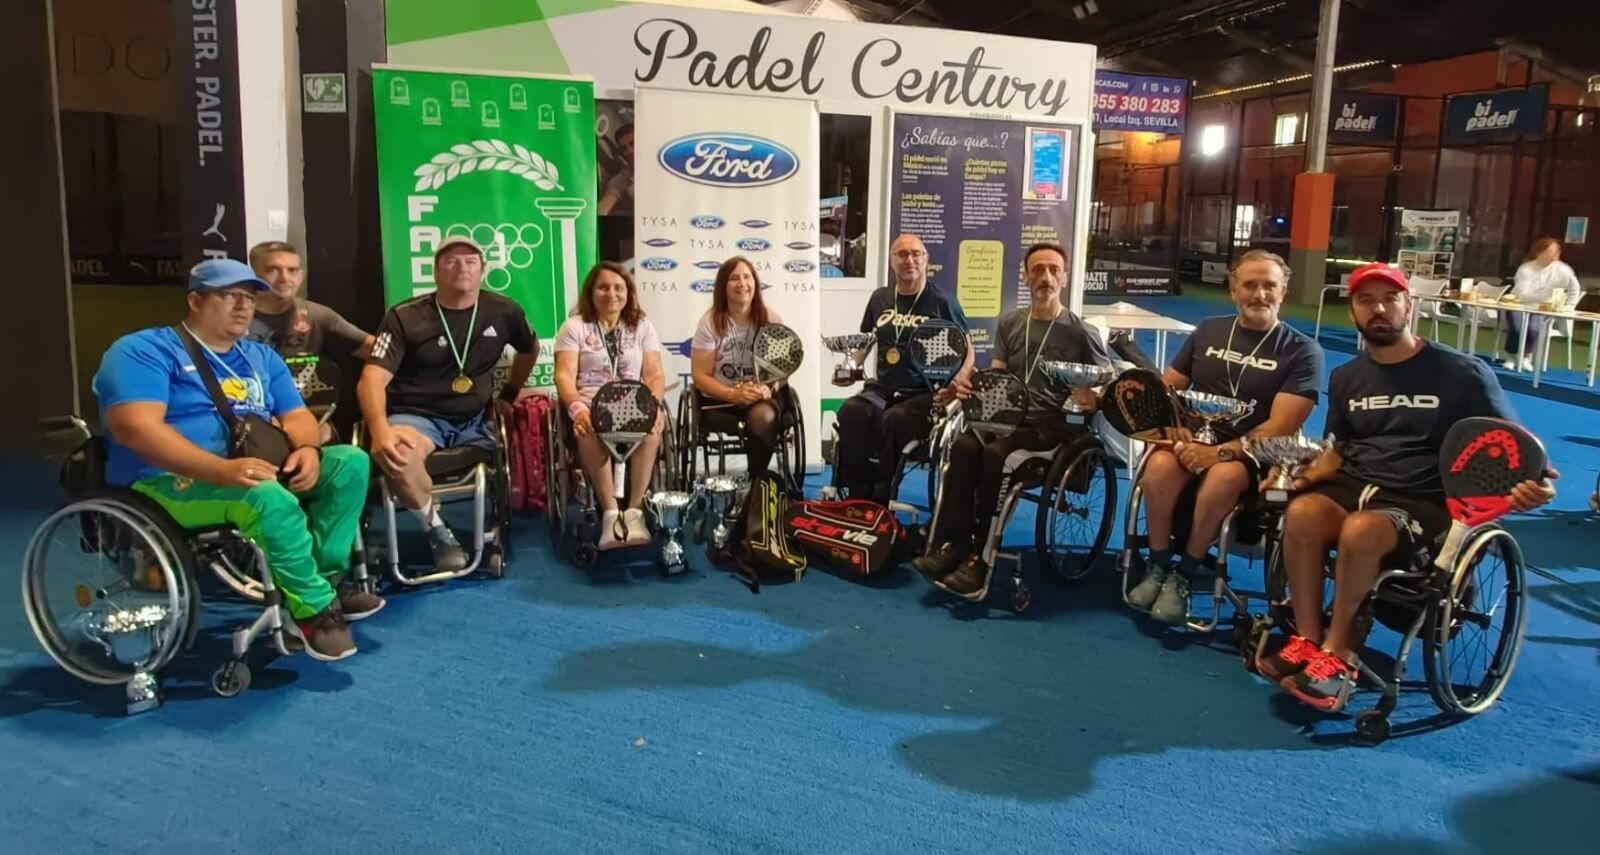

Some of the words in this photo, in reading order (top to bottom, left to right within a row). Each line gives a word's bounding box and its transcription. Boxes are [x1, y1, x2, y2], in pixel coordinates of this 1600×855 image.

[634, 18, 826, 95] Padel
[851, 38, 1069, 116] Century
[1119, 96, 1147, 112] 380
[1150, 98, 1181, 114] 283
[1341, 102, 1357, 118] bi
[1475, 100, 1493, 117] bi
[197, 77, 224, 166] PADEL.
[1104, 114, 1126, 124] Local
[1144, 116, 1179, 127] SEVILLA
[901, 126, 959, 149] ¿Sabías
[685, 139, 775, 180] Ford
[642, 216, 677, 227] TYSA
[784, 221, 816, 230] TYSA
[690, 238, 725, 249] TYSA
[757, 261, 772, 271] SA
[642, 281, 677, 292] TYSA
[784, 282, 816, 292] TYSA
[1205, 346, 1278, 371] HEAD
[1349, 394, 1440, 412] HEAD
[789, 515, 879, 546] starvie
